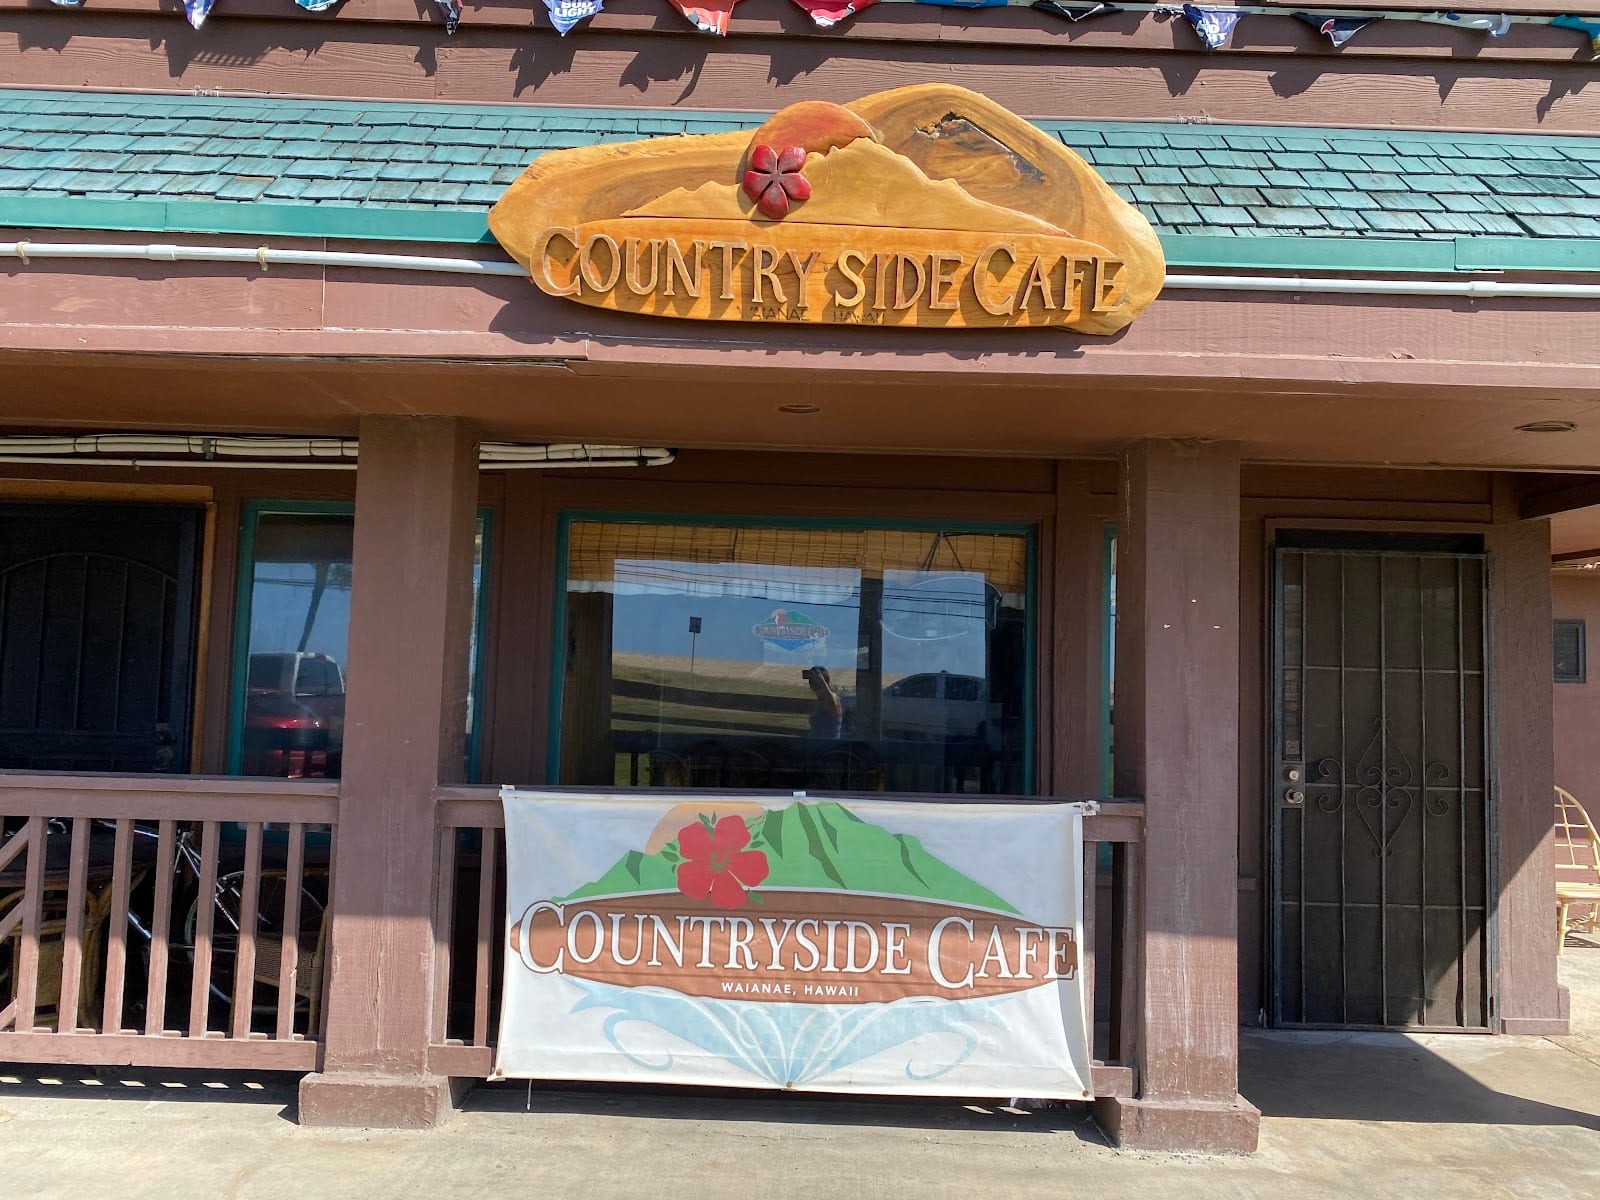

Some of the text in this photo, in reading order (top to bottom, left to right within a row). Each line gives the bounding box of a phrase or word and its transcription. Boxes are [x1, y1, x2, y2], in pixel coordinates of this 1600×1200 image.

[555, 6, 597, 18] LIGHT
[973, 242, 1124, 316] CAFE
[737, 305, 810, 321] AIANAE
[519, 902, 1074, 989] COUNTRYSIDE CAFE
[722, 982, 859, 996] WAIANAE, HAWAII
